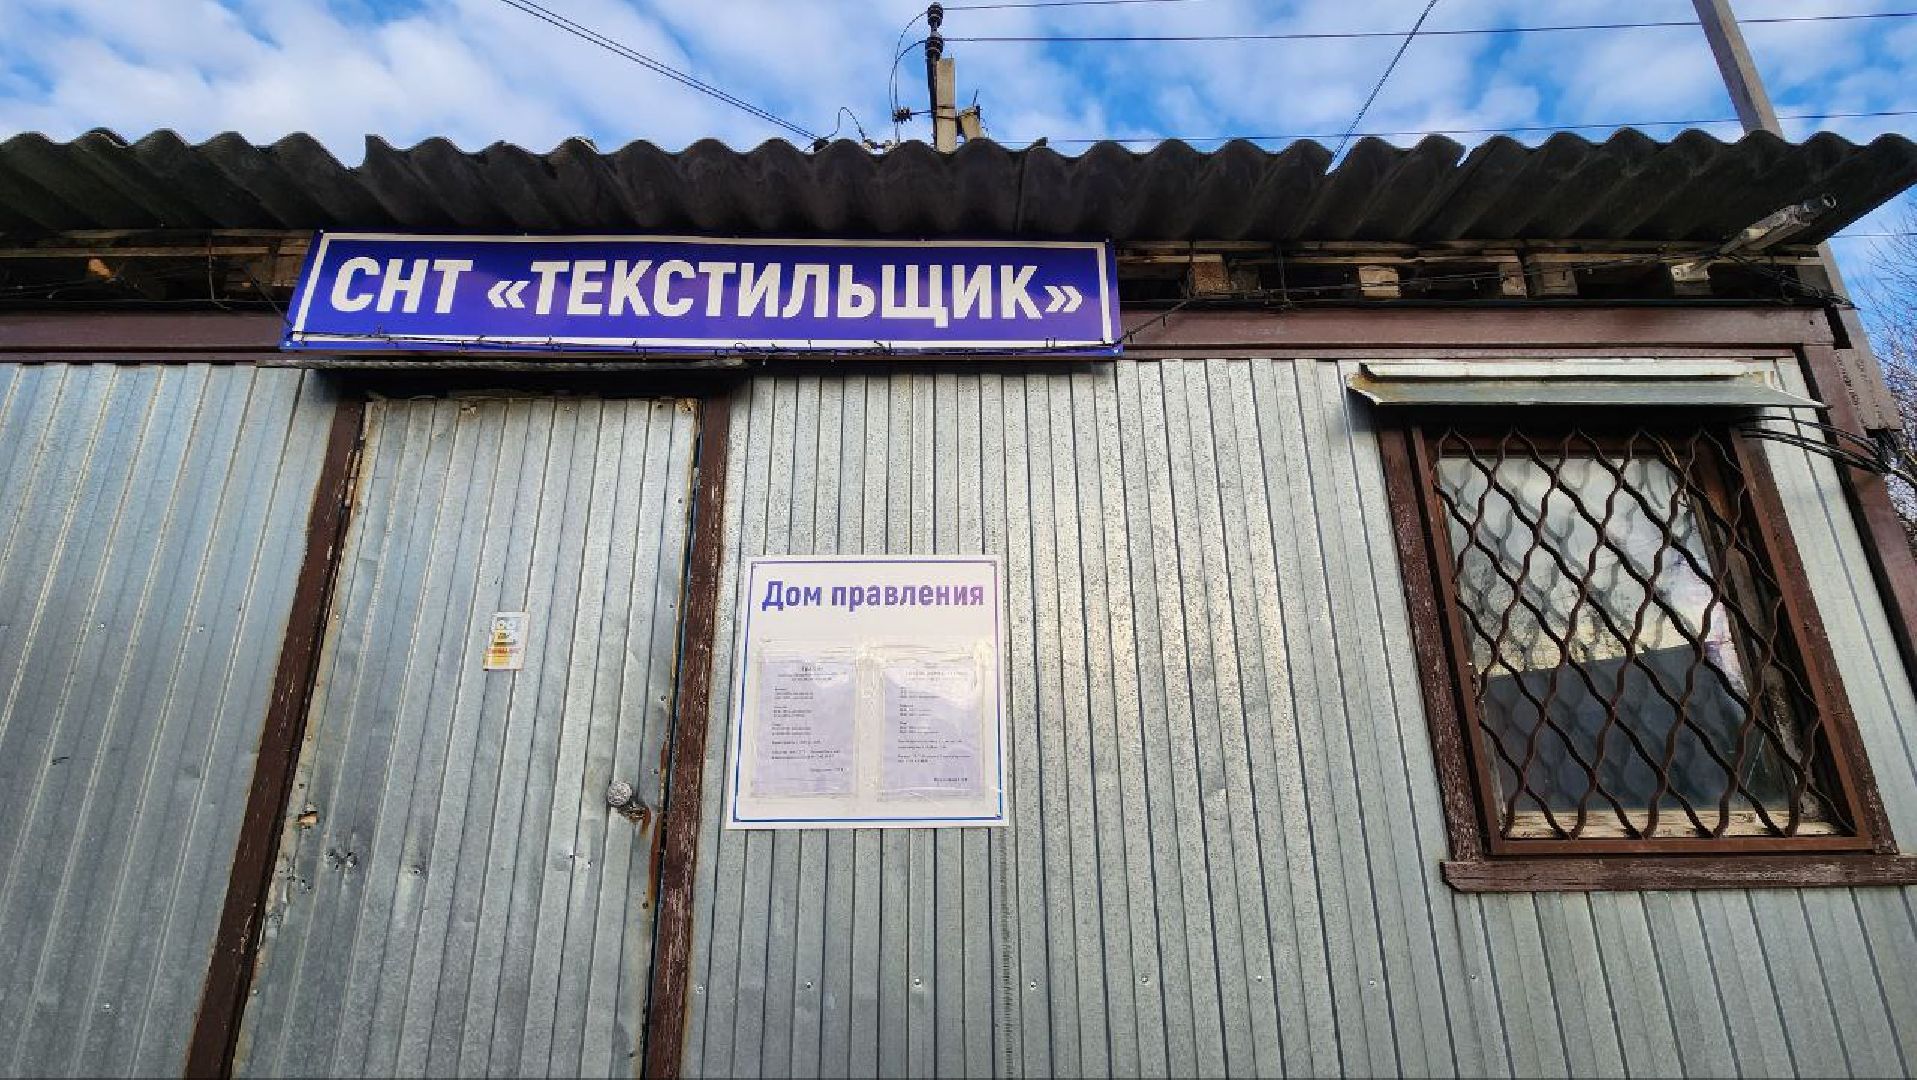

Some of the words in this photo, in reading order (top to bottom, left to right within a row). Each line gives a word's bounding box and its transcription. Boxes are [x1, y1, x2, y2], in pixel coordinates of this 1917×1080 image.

[330, 255, 474, 316] СНТ
[487, 259, 1084, 328] «ТЕКСТИЛЬЩИК»
[761, 580, 822, 611] Дом
[831, 584, 985, 612] правления
